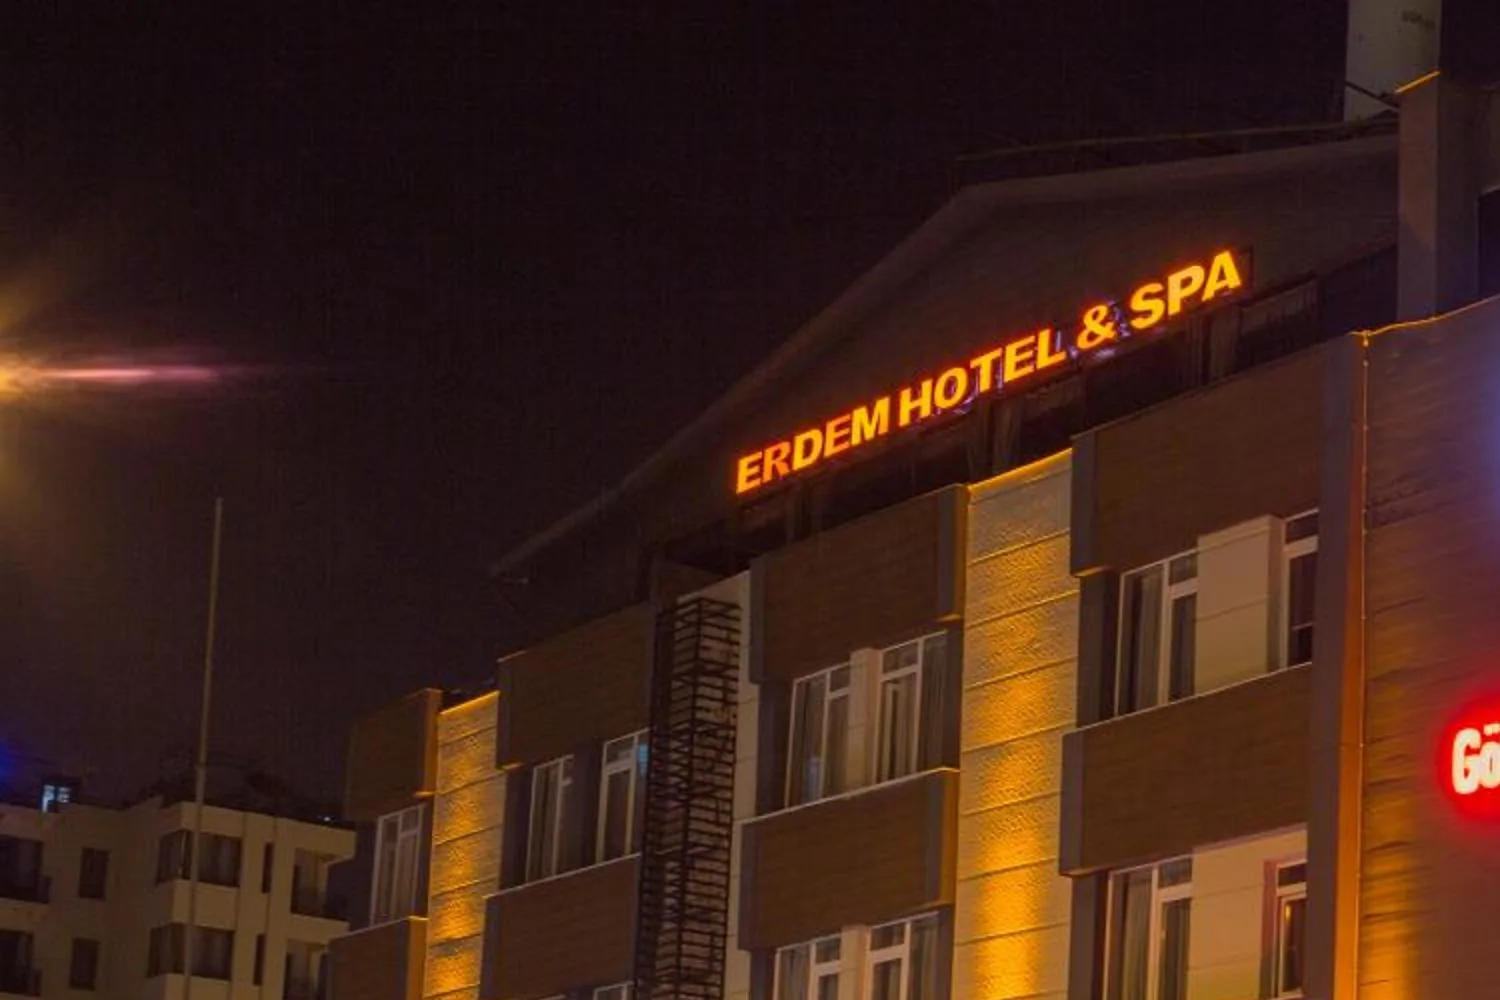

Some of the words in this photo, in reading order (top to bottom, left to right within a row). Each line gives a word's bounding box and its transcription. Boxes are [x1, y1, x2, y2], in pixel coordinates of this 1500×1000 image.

[736, 395, 890, 494] ERDEM
[899, 328, 1066, 427] HOTEL
[1076, 304, 1116, 350] &
[1129, 251, 1242, 330] SPA
